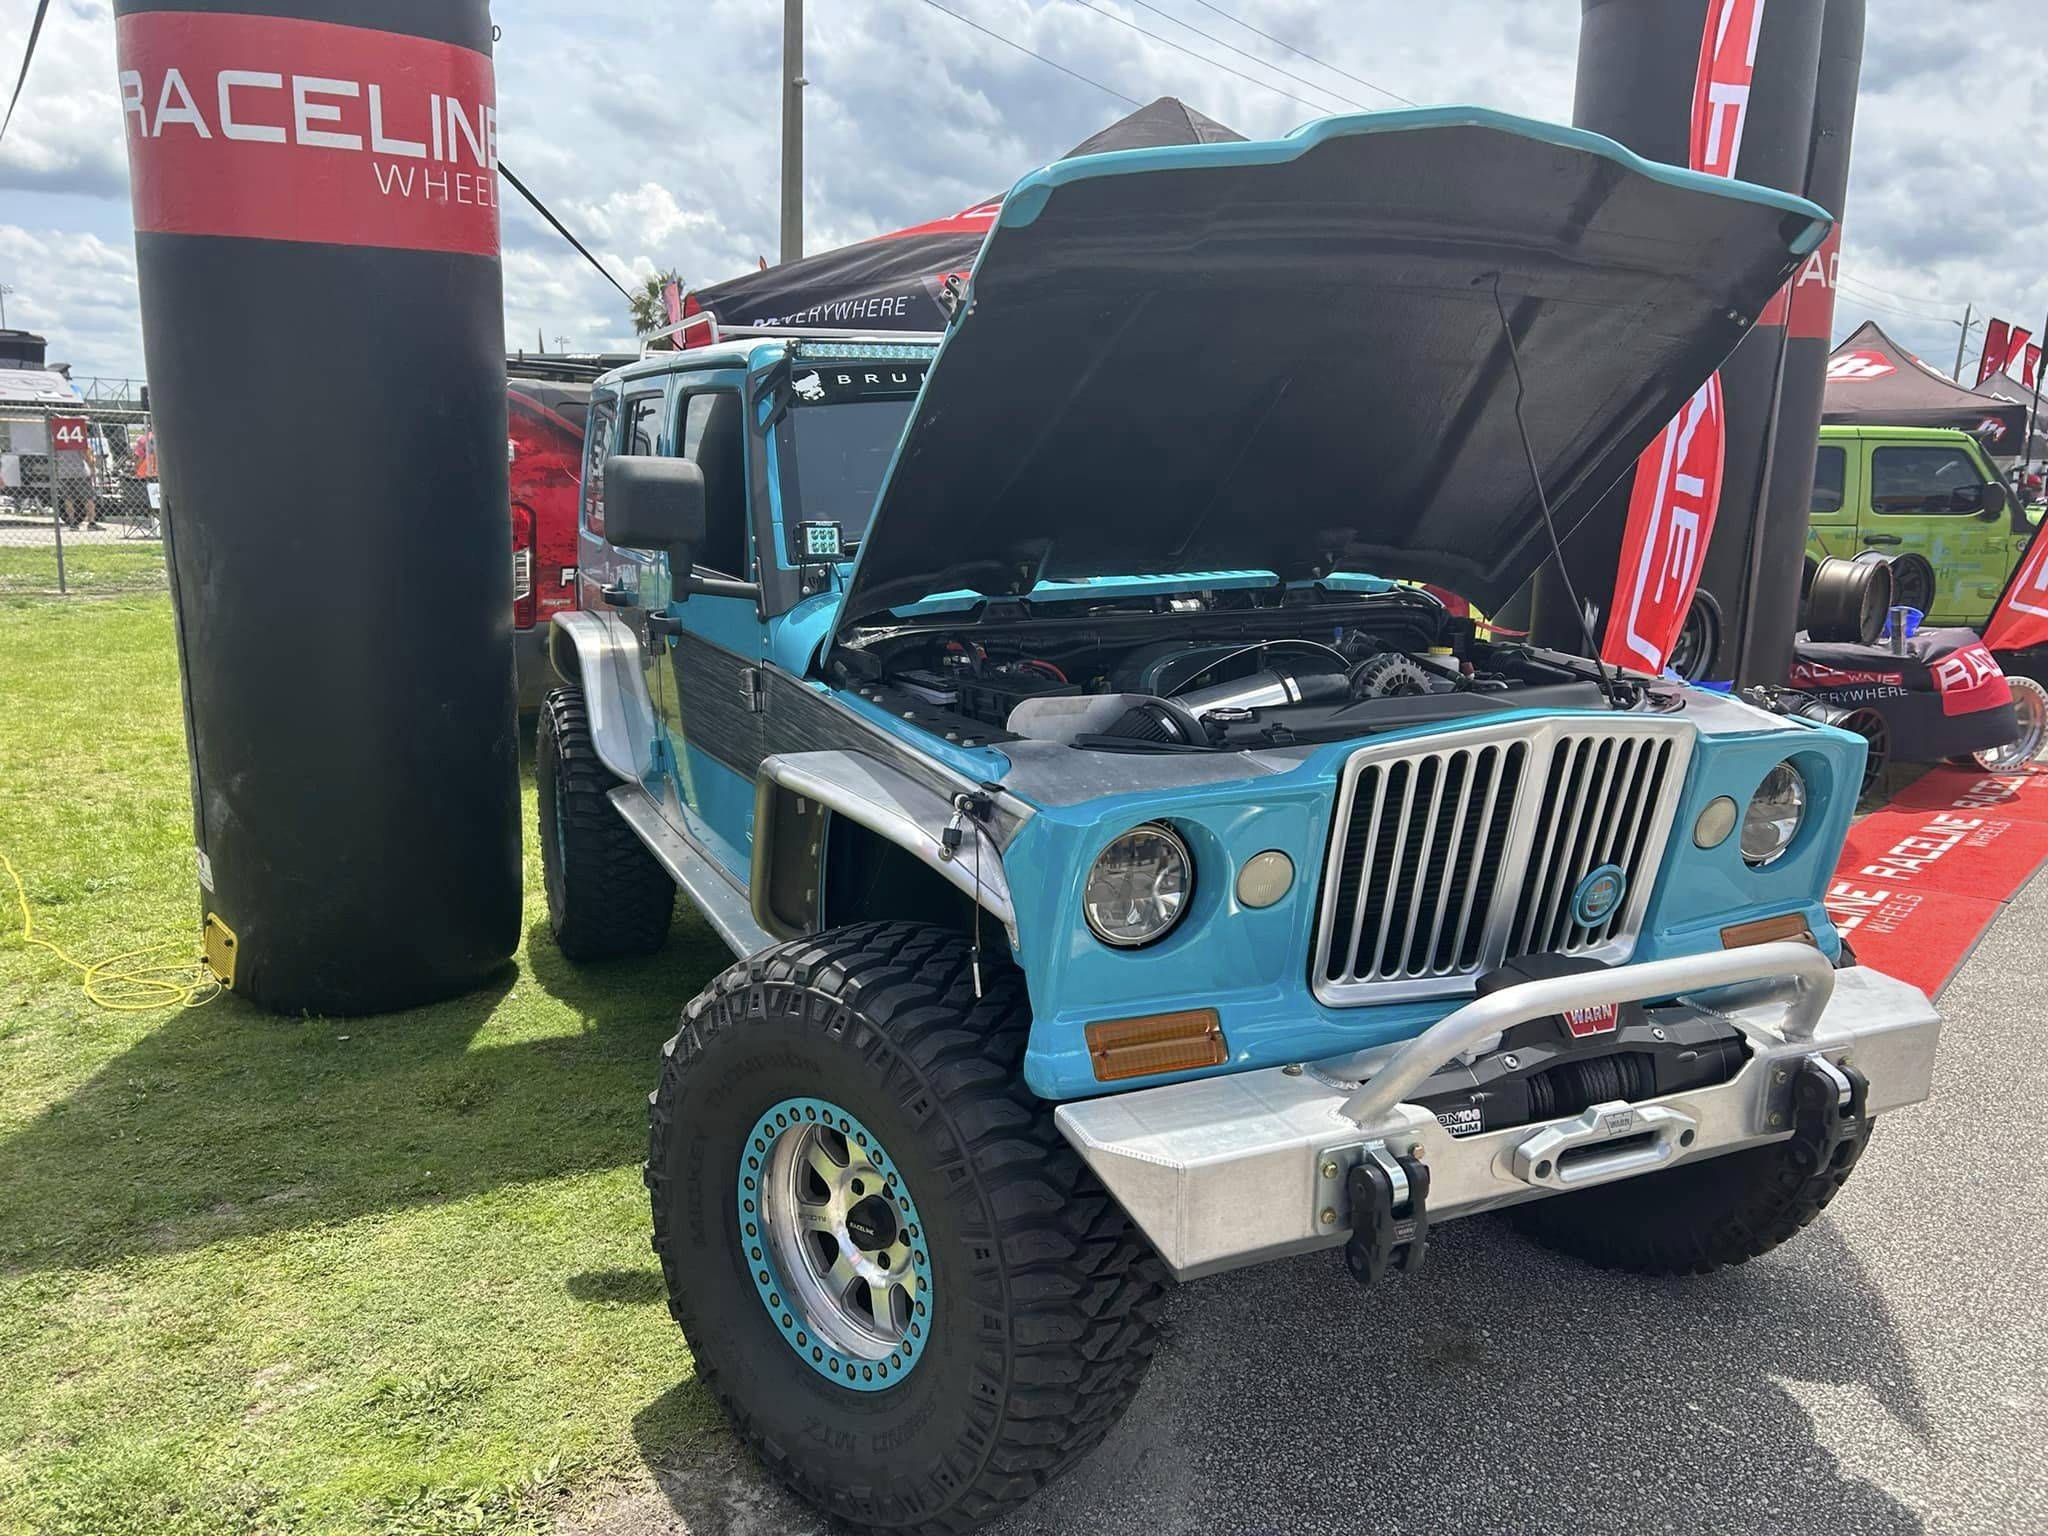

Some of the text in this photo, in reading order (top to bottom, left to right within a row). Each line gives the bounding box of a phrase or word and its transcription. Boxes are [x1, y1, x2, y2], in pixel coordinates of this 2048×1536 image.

[780, 296, 908, 325] VERYWHERE
[56, 425, 84, 443] 44
[1800, 686, 1908, 703] EERYWHERE
[1859, 813, 1984, 880] RACELINE
[1963, 820, 2012, 847] WHEELS
[1823, 881, 1891, 938] LINE
[1864, 893, 1923, 933] WHEELS
[1570, 1003, 1612, 1024] WARN
